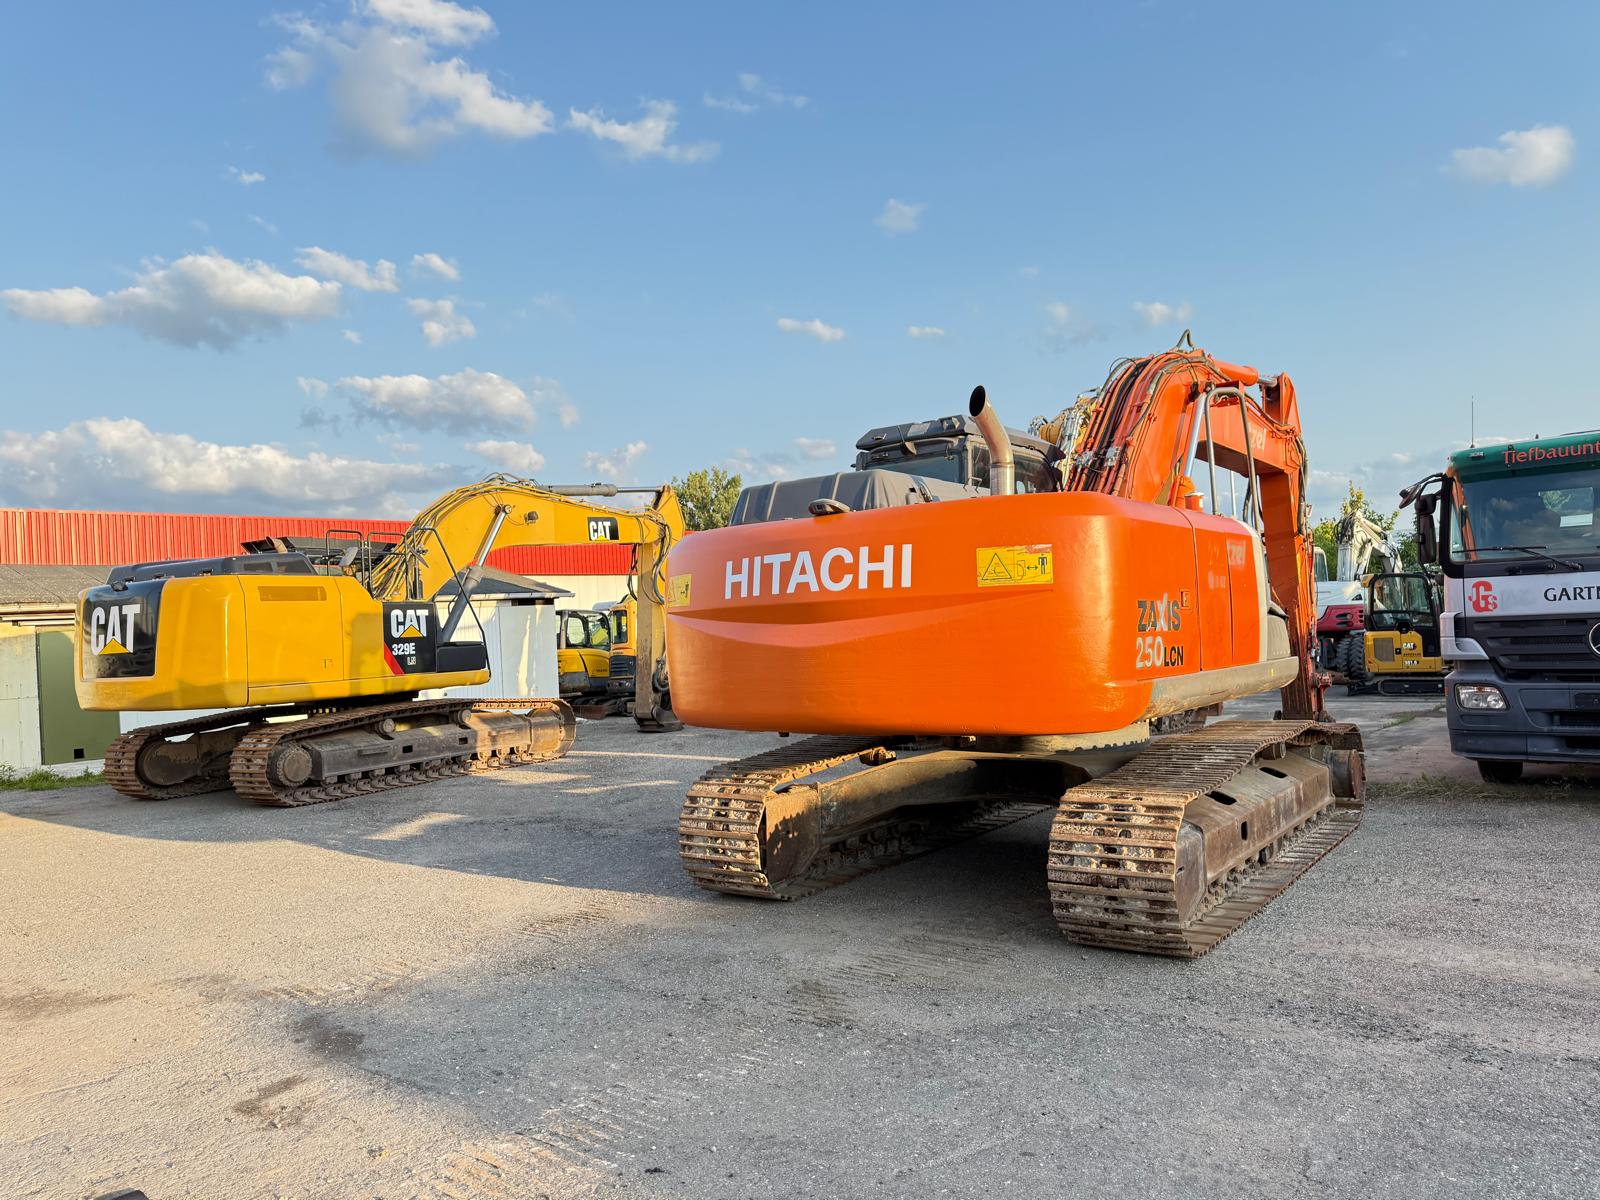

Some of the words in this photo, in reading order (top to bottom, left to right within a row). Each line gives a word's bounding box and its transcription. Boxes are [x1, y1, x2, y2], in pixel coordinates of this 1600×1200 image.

[590, 521, 611, 541] CAT
[725, 543, 913, 600] HITACHI
[390, 609, 429, 638] CAT
[1137, 592, 1181, 632] ZAXIS
[91, 603, 141, 656] CAT
[392, 643, 416, 656] 329E
[1402, 642, 1415, 650] CAT
